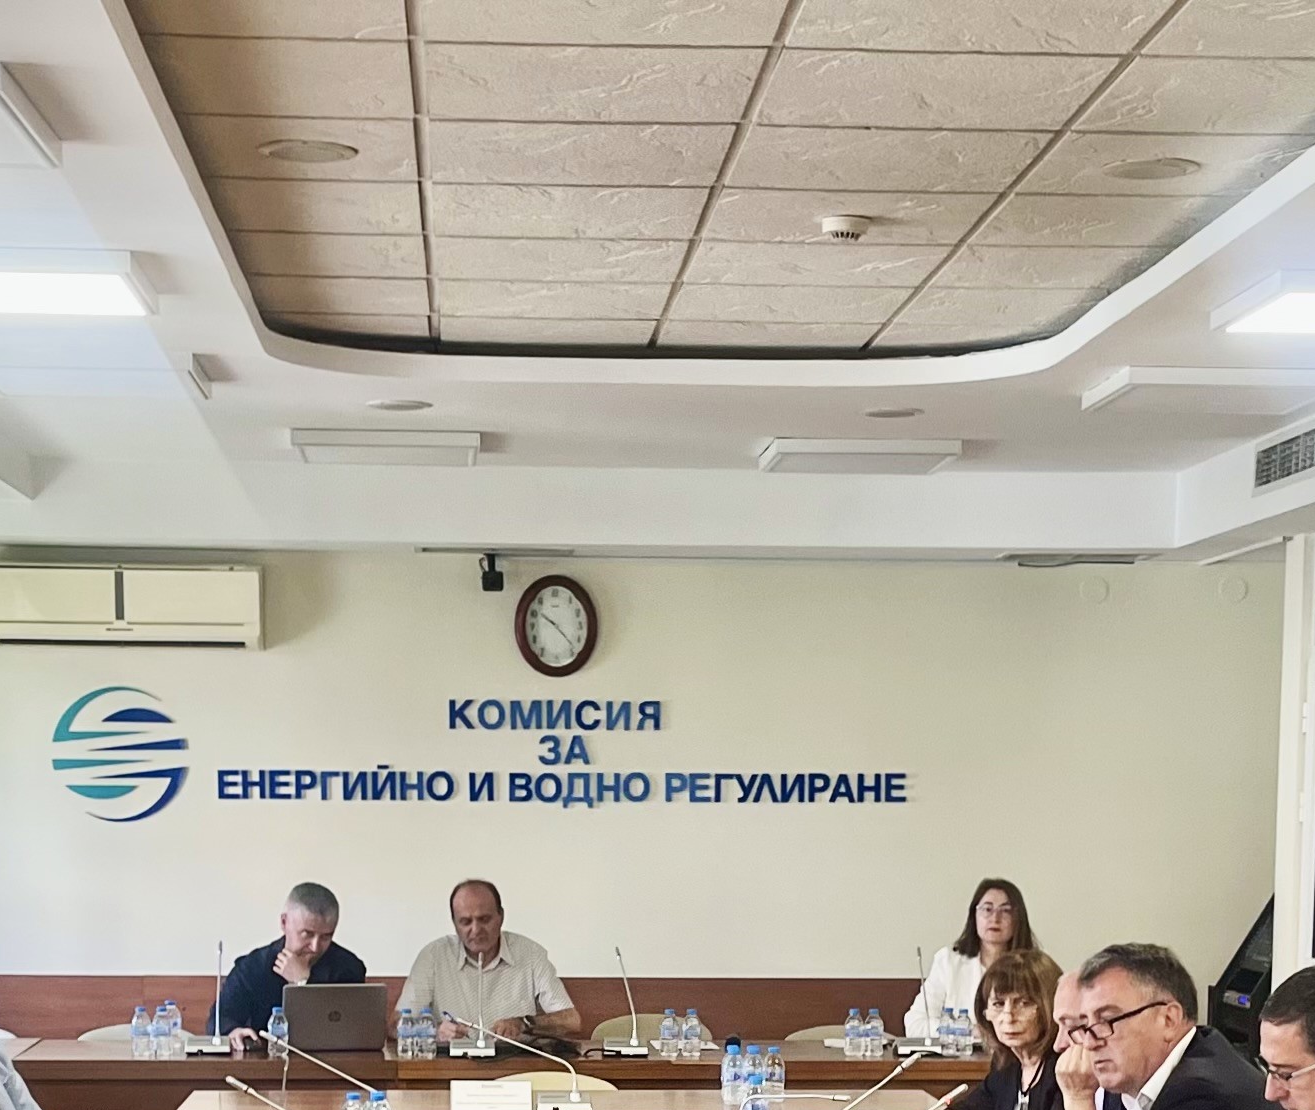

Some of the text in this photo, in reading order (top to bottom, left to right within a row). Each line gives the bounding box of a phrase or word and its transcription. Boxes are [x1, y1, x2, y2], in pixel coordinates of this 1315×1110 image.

[448, 699, 661, 731] КОМИСИЯ
[538, 734, 591, 765] ЗА
[217, 764, 907, 809] ЕНЕРГИЙНО И ВОДНО РЕГУЛИРАНЕ
